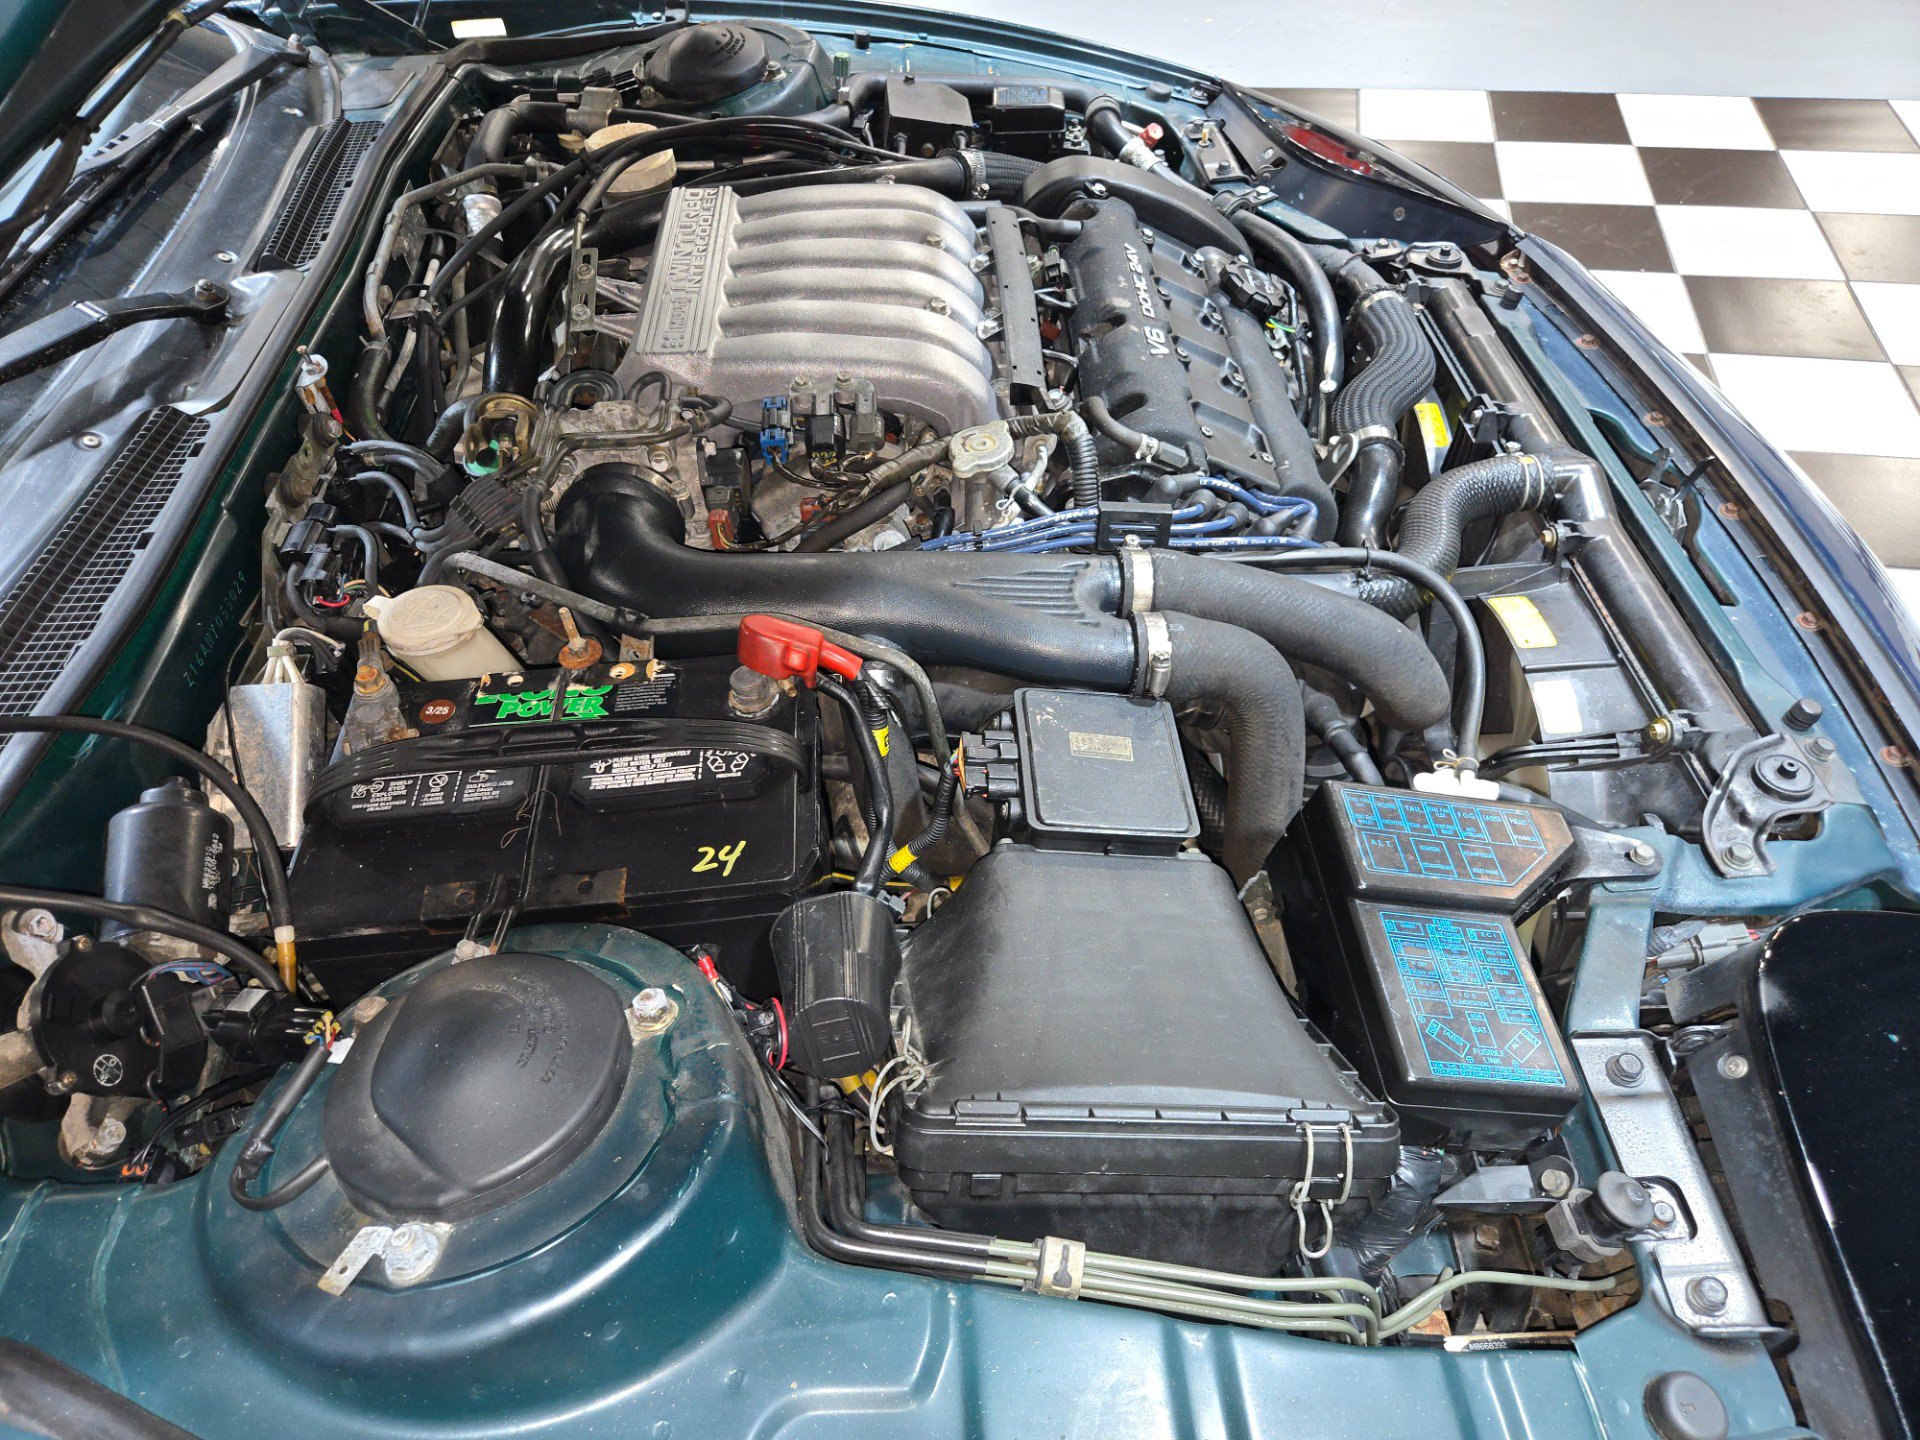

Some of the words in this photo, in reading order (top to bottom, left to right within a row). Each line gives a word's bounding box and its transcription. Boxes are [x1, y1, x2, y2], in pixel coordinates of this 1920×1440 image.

[685, 188, 719, 294] INTERCOOLER
[1123, 242, 1143, 274] 24V
[1132, 273, 1155, 319] DOHC
[1143, 326, 1170, 355] V6
[1212, 479, 1240, 492] POWER
[424, 705, 449, 716] 3/25
[495, 696, 609, 719] POWER
[651, 750, 691, 759] IMMEDIATELY
[656, 761, 673, 769] FAST
[465, 781, 498, 789] SULFURIC
[371, 789, 408, 798] EXPLOSIVE
[1405, 804, 1424, 813] TAIL
[1457, 811, 1477, 820] FOG
[691, 840, 747, 877] 24
[1473, 1047, 1507, 1058] FUSIBLE
[1482, 1056, 1503, 1066] LINK
[1469, 1341, 1507, 1350] MB668392
